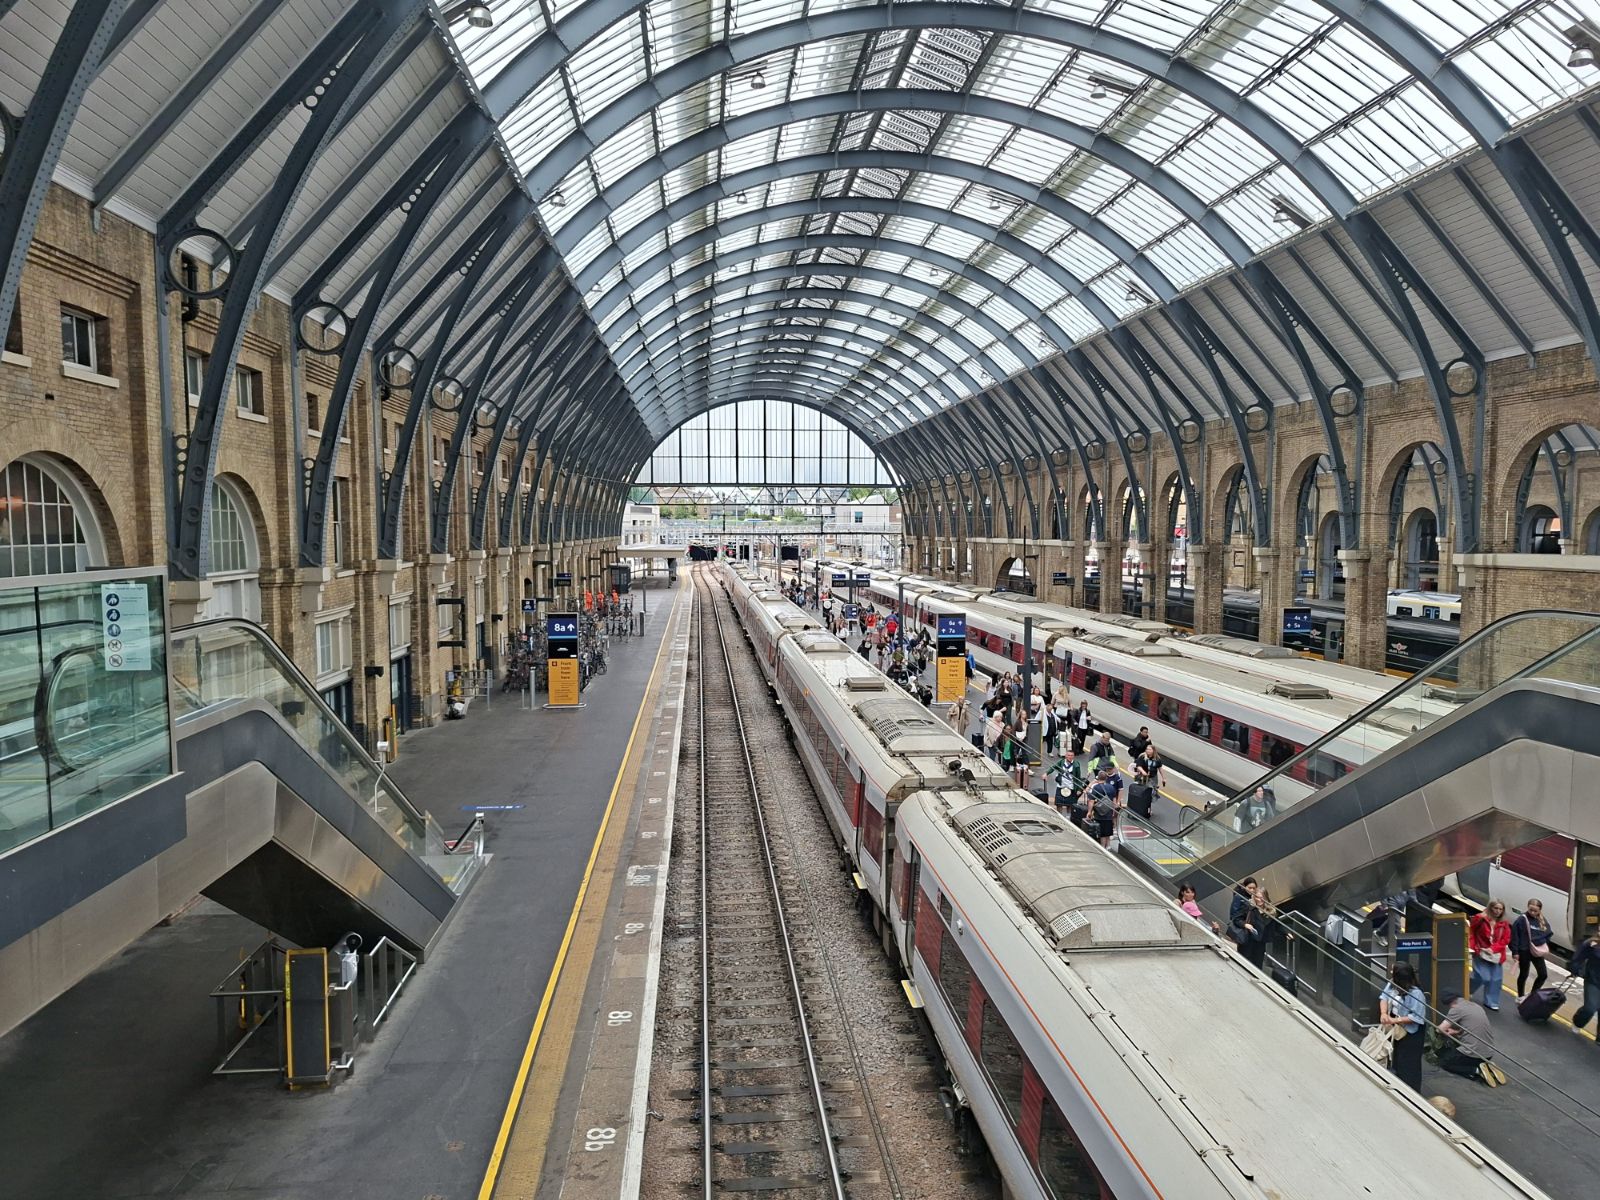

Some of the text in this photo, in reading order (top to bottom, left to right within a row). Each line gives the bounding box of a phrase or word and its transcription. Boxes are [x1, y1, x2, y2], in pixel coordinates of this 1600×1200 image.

[554, 623, 566, 632] 8a
[624, 922, 645, 935] 8b
[607, 1010, 633, 1026] 8b
[584, 1127, 617, 1152] 8b
